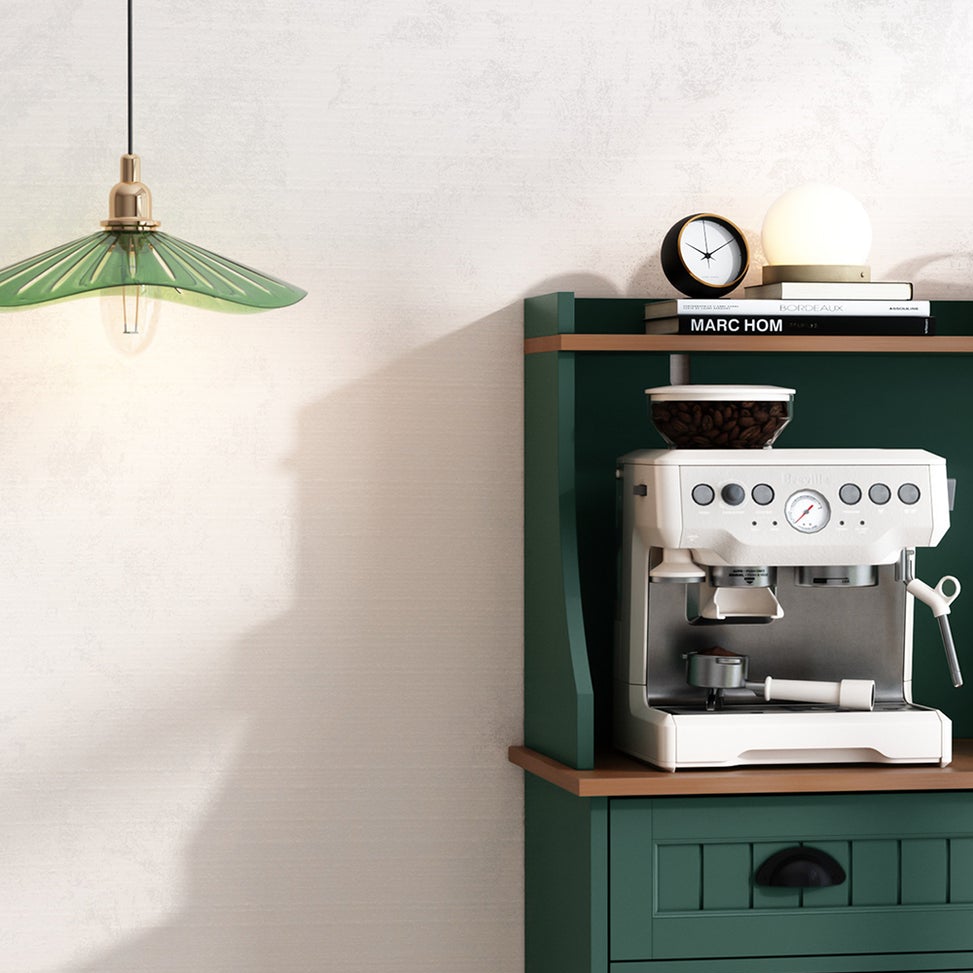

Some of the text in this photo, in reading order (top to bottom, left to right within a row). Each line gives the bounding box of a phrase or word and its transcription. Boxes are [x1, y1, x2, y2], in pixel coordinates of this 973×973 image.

[779, 304, 844, 312] BORDEAUX
[690, 318, 739, 331] MARC
[743, 318, 783, 331] HOM
